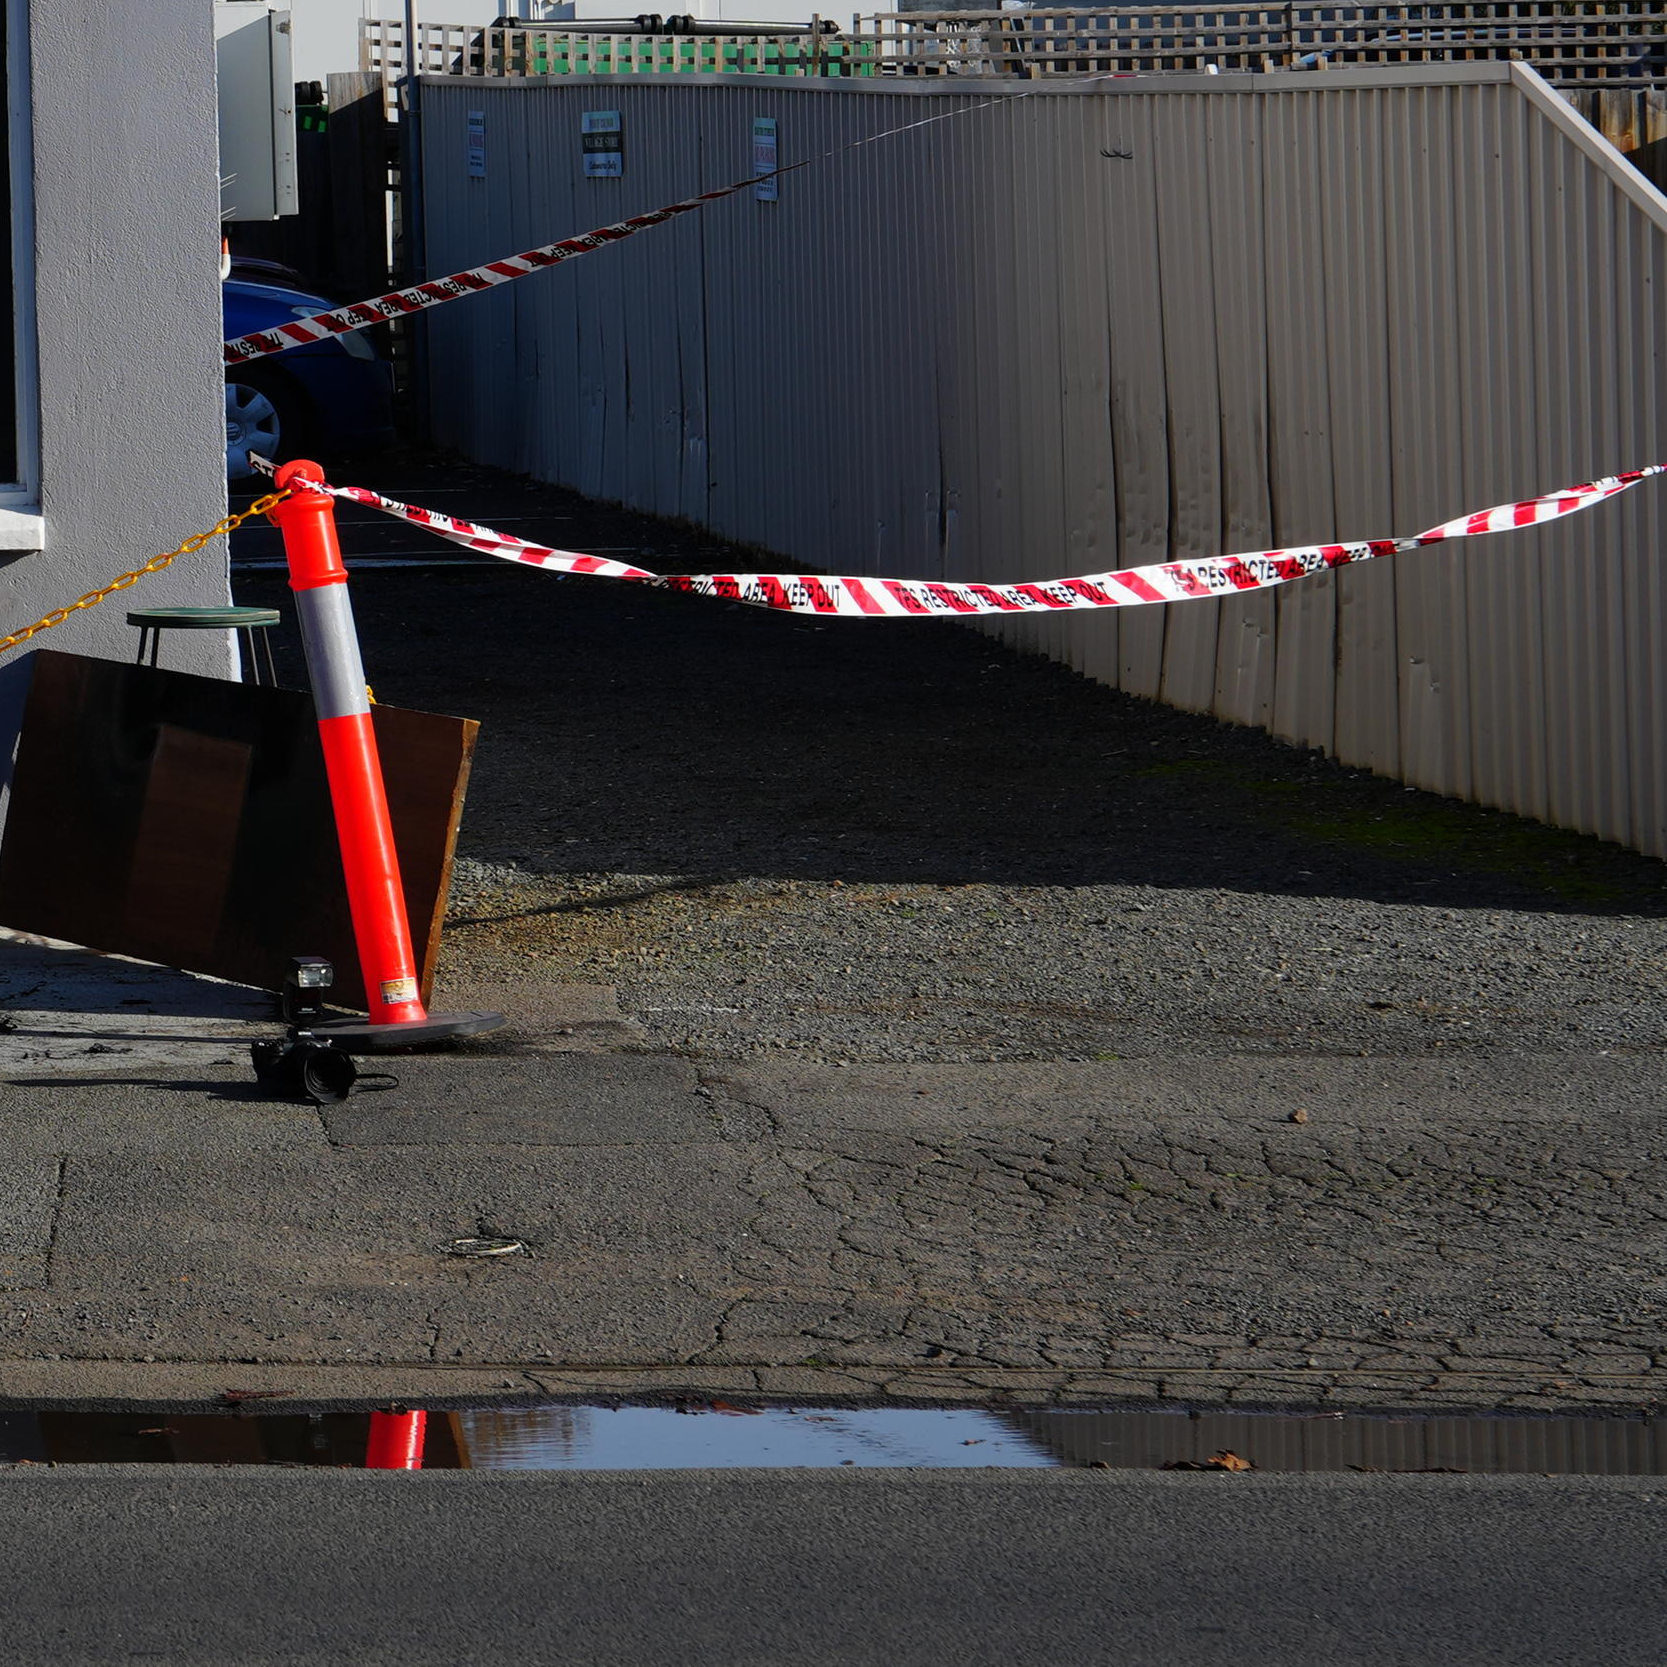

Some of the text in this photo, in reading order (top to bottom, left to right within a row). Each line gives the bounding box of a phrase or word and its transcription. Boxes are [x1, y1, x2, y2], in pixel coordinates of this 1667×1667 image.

[1289, 553, 1325, 574] AREA
[782, 583, 815, 606] KEEP
[817, 584, 840, 608] OUT
[895, 581, 1107, 610] TFS RESTRICTED AREA KEEP OUT
